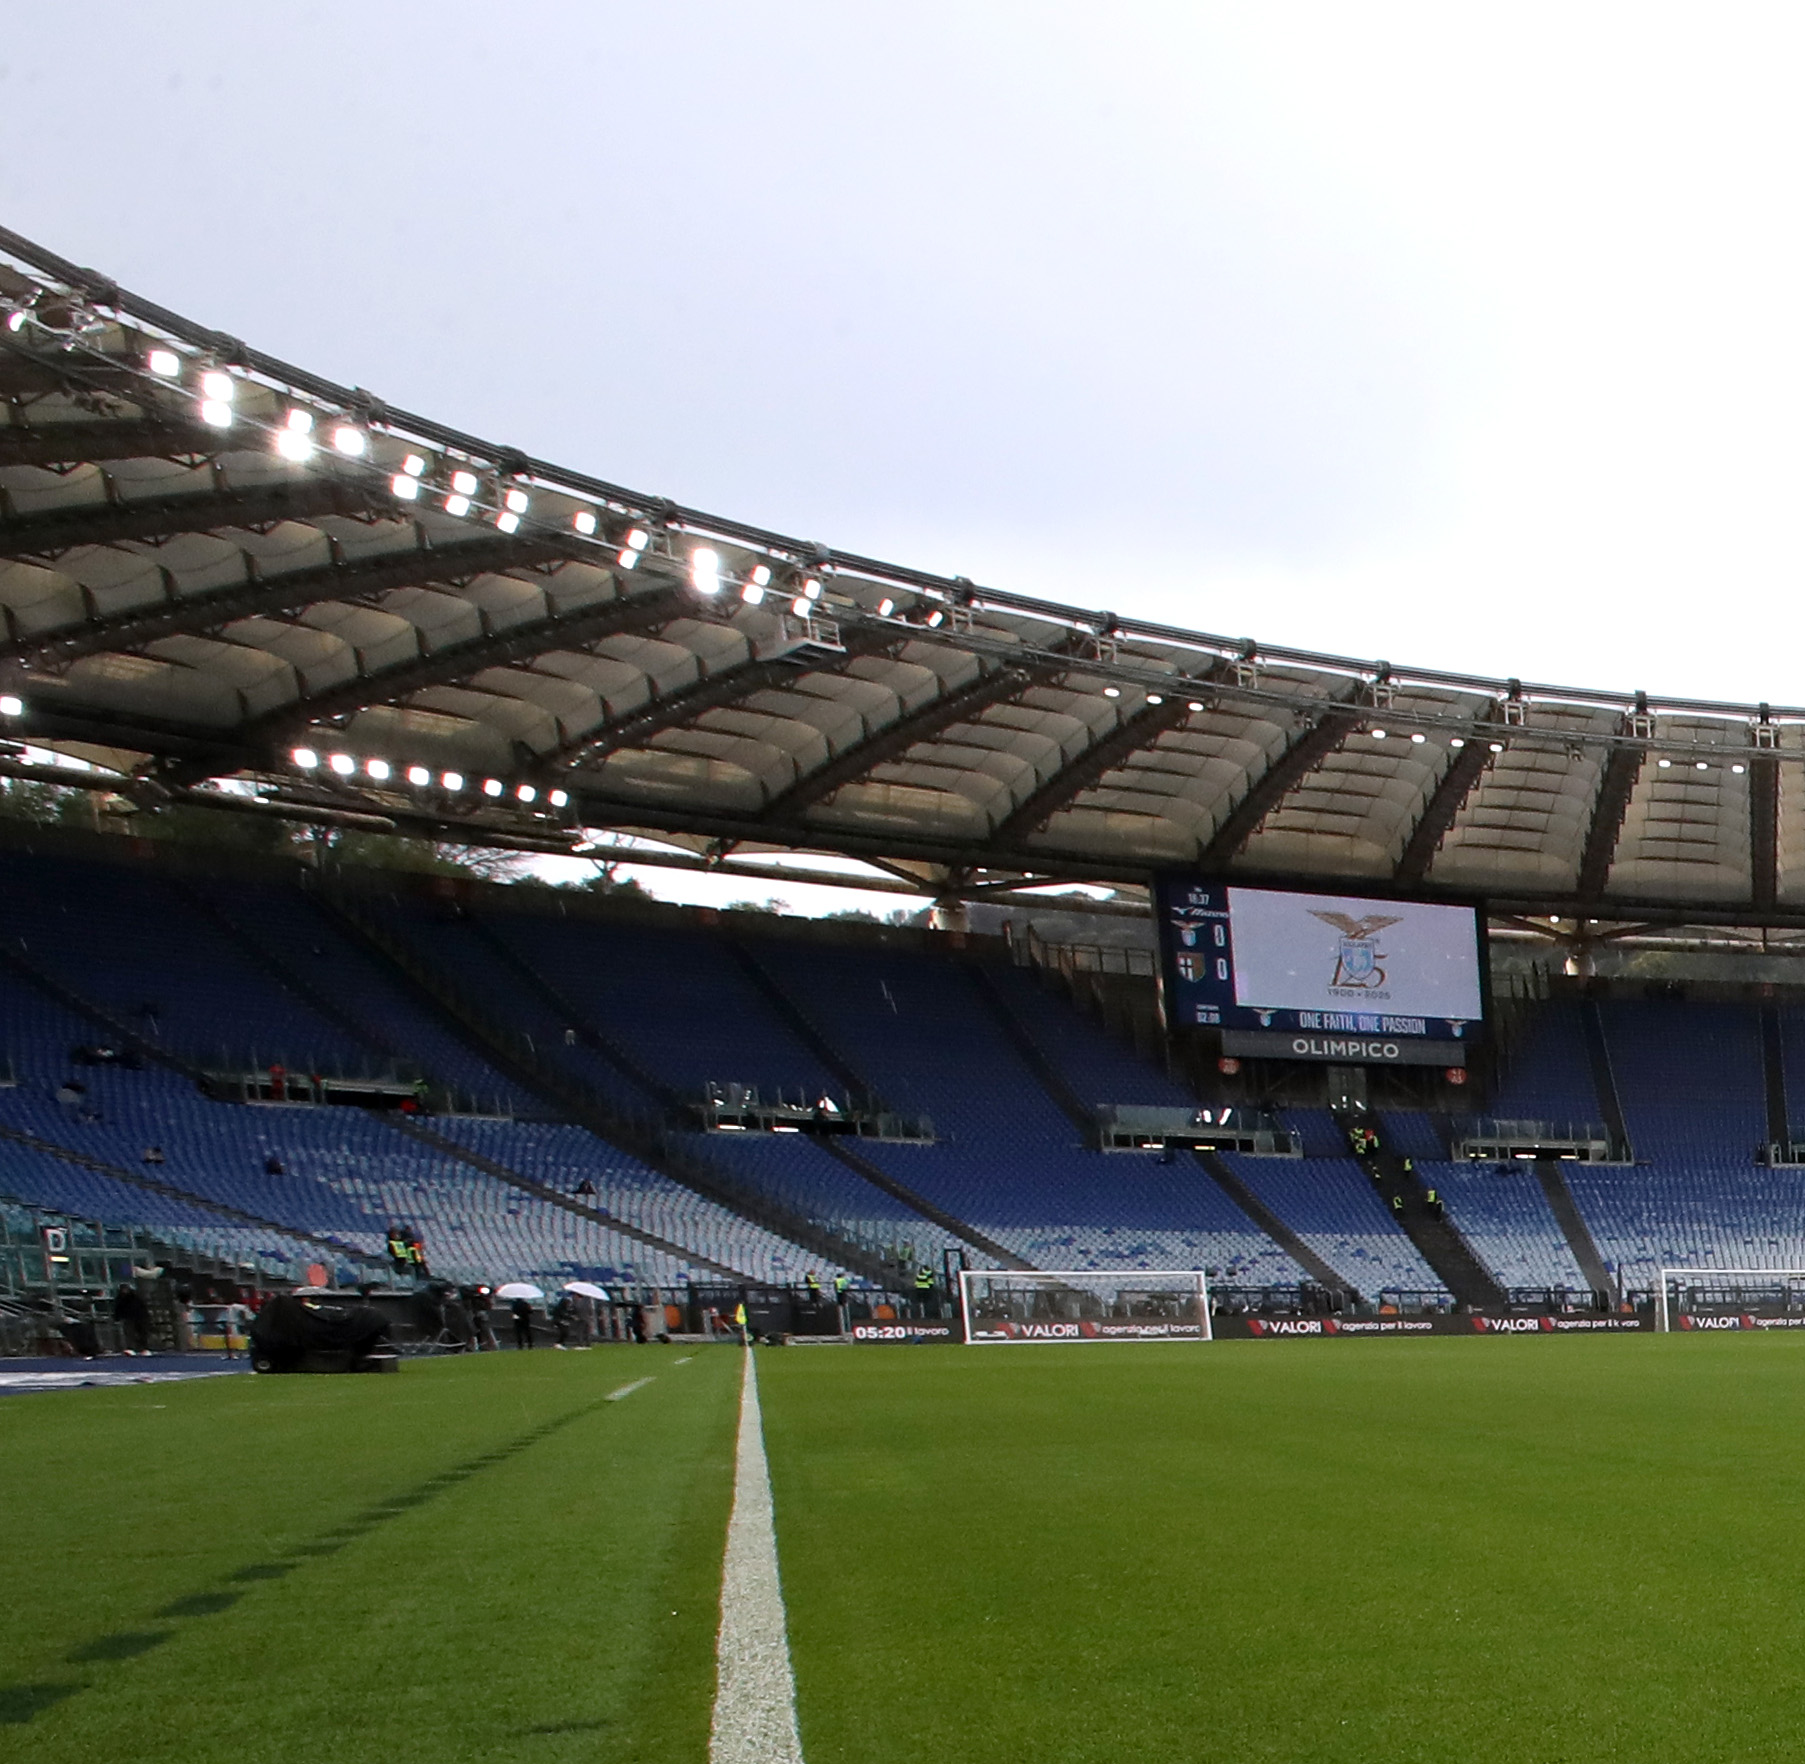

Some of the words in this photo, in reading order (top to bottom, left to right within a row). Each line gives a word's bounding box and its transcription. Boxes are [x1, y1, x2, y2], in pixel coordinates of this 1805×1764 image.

[1215, 924, 1225, 946] 0
[1217, 957, 1228, 980] 0
[1300, 1012, 1320, 1029] ONE
[1324, 1013, 1357, 1033] FAITH,
[1358, 1016, 1380, 1032] ONE
[1382, 1016, 1426, 1034] PASSION
[1292, 1038, 1400, 1059] OLIMPICO
[854, 1326, 906, 1339] 05:20
[914, 1327, 950, 1336] lavoro
[1021, 1324, 1079, 1337] VALORI
[1270, 1321, 1321, 1333] VALORI
[1491, 1319, 1538, 1330] VALORI
